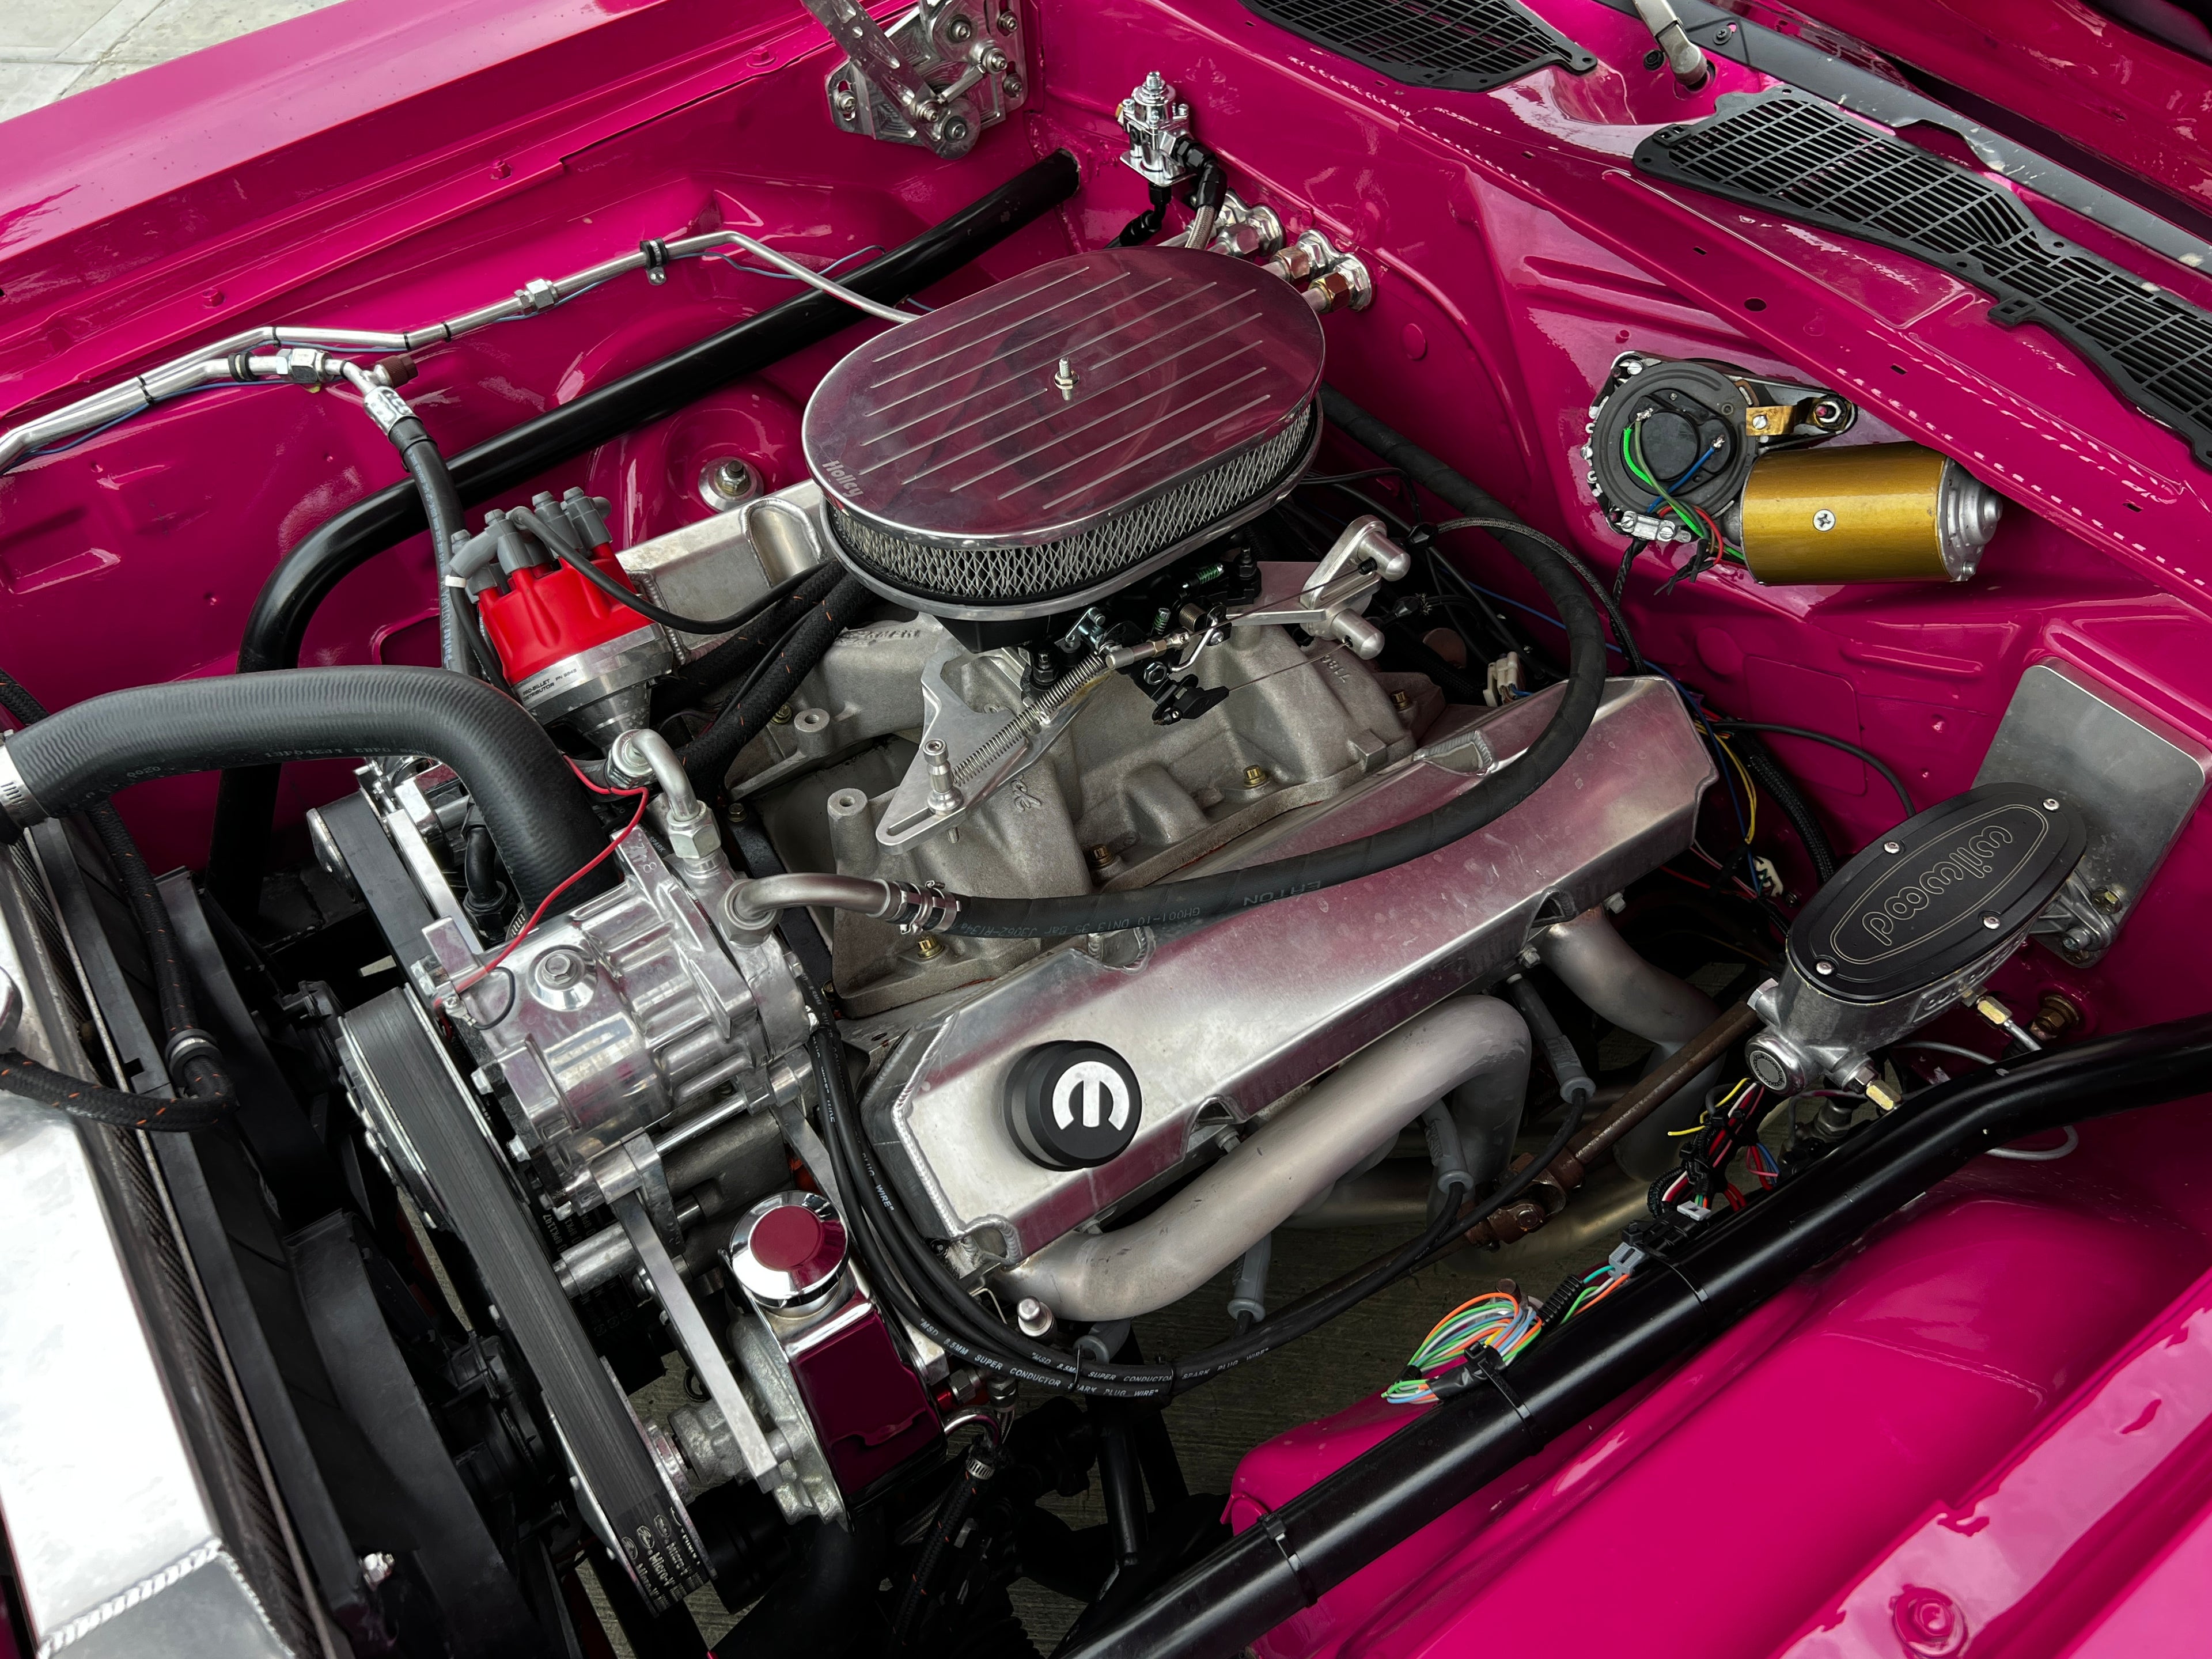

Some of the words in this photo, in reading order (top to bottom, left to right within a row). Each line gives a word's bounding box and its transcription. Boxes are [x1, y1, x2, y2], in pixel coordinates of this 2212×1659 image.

[822, 460, 863, 498] Holley
[441, 589, 450, 628] FUTURA
[443, 628, 453, 665] Parker
[522, 679, 550, 696] PRO-BILLET
[522, 682, 555, 702] DISTRIBUTOR
[649, 836, 666, 854] SPARK
[1243, 880, 1321, 906] EATON
[1862, 824, 2013, 947] wilwood
[1075, 923, 1090, 934] 35
[1097, 919, 1129, 928] DN13
[1137, 907, 1200, 926] GH001-10
[1044, 926, 1067, 935] Bar
[876, 1184, 895, 1211] WIRE"
[543, 1214, 563, 1244] 8PK1147
[943, 1338, 969, 1355] 8.5MM
[974, 1354, 1003, 1370] SUPER
[1009, 1367, 1062, 1387] CONDUCTOR
[1103, 1388, 1127, 1397] PLUG
[1134, 1389, 1159, 1397] WIRE"
[1056, 1363, 1077, 1374] 8.5M
[1088, 1371, 1117, 1381] SUPER
[1181, 1368, 1211, 1380] SPARK
[649, 1551, 676, 1587] Micro-V
